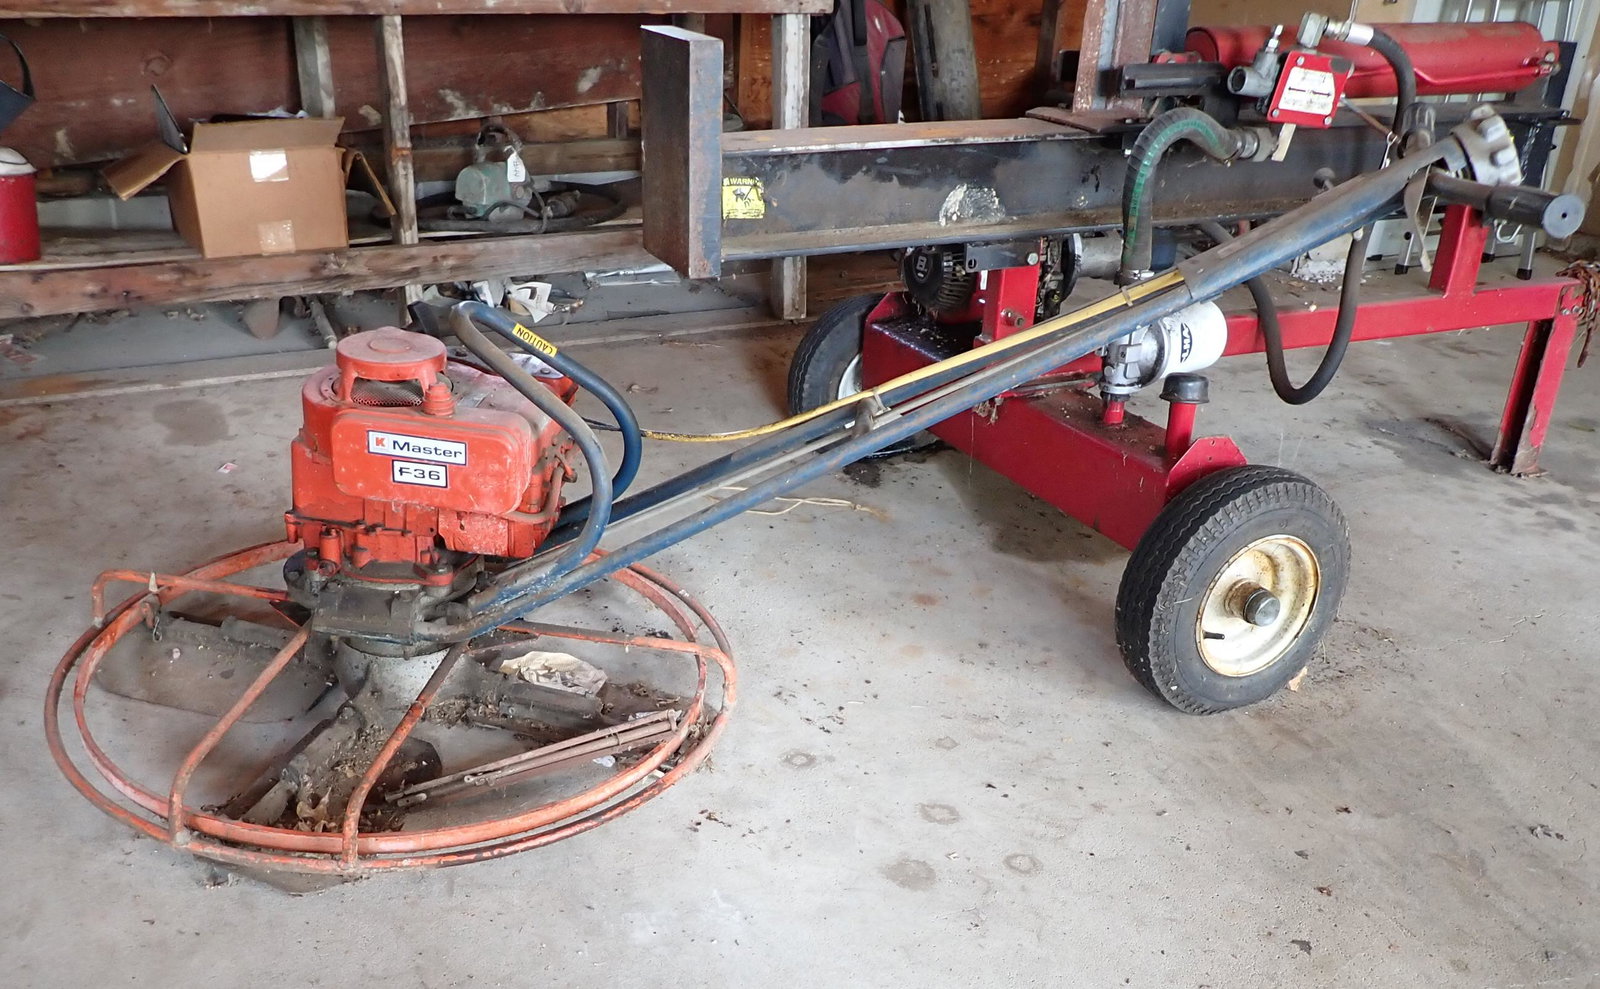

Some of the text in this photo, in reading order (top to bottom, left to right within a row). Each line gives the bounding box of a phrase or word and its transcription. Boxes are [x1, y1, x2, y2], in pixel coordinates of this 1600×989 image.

[517, 327, 553, 355] CAUTION
[375, 437, 462, 458] K Master
[398, 467, 441, 481] F36
